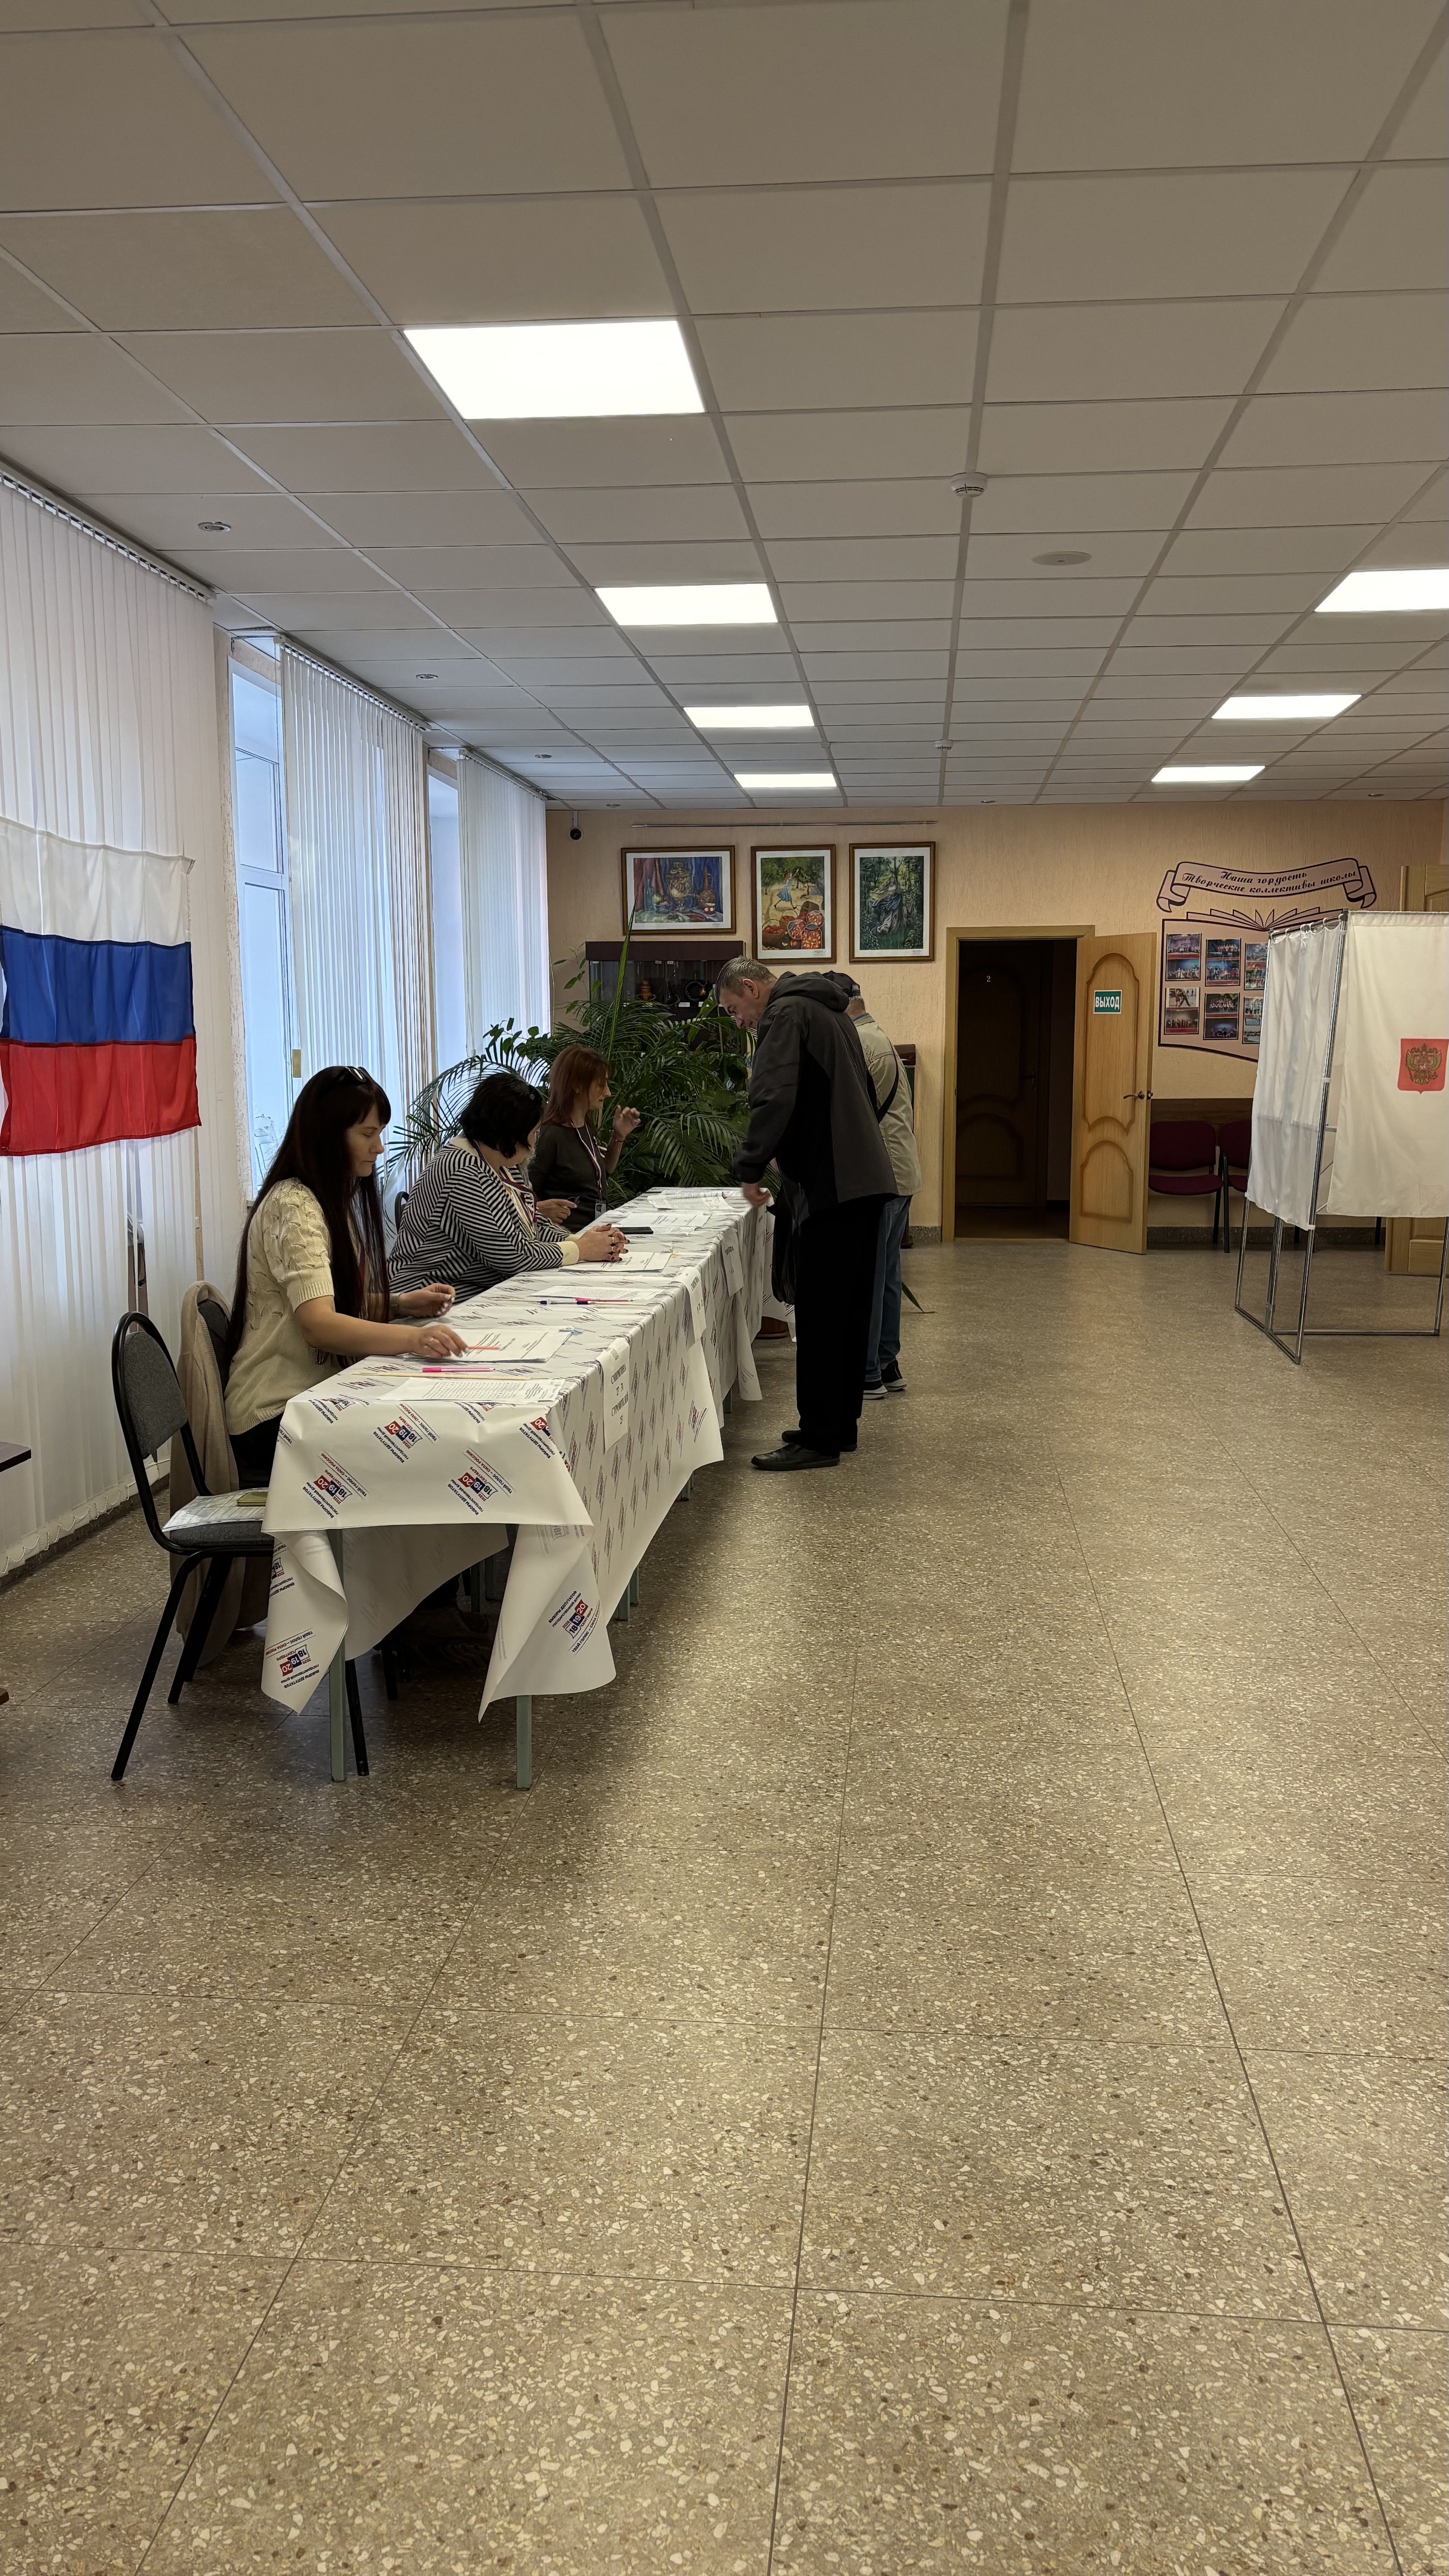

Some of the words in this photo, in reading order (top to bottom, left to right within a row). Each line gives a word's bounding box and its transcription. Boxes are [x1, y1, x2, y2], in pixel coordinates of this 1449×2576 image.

[1182, 873, 1246, 892] Творческие
[1249, 880, 1316, 893] коллективы
[1320, 871, 1357, 885] школы
[1221, 872, 1253, 884] Наша
[1257, 873, 1307, 887] гордость
[1095, 996, 1120, 1010] ВЫХОД
[321, 1411, 333, 1423] ВЫБОРЫ
[388, 1423, 399, 1433] 20
[534, 1419, 545, 1429] 20
[398, 1428, 408, 1438] 19
[408, 1433, 418, 1442] 18
[519, 1427, 538, 1445] ДЕПУТАТОВ
[283, 1434, 292, 1444] ТВОЙ
[373, 1431, 391, 1449] ДЕПУТАТОВ
[390, 1448, 404, 1463] ВЫБОРЫ
[537, 1444, 551, 1458] ВЫБОРЫ
[317, 1478, 328, 1488] 20
[347, 1477, 358, 1488] ГОЛОС
[461, 1475, 473, 1486] 20
[492, 1474, 504, 1485] ГОЛОС
[328, 1484, 338, 1493] 19
[473, 1481, 483, 1490] 19
[483, 1485, 493, 1495] 18
[502, 1484, 512, 1493] ТВОЙ
[303, 1486, 321, 1505] ДЕПУТАТОВ
[337, 1488, 348, 1498] 18
[357, 1487, 367, 1496] ТВОЙ
[447, 1483, 466, 1502] ДЕПУТАТОВ
[320, 1504, 334, 1518] ВЫБОРЫ
[465, 1501, 478, 1515] ВЫБОРЫ
[548, 1609, 561, 1623] ВЫБОРЫ
[560, 1590, 577, 1610] ДЕПУТАТОВ
[576, 1603, 586, 1614] 20
[572, 1614, 582, 1624] 19
[569, 1624, 578, 1634] 18
[298, 1648, 306, 1657] 18
[290, 1656, 299, 1665] 19
[282, 1663, 291, 1672] 20
